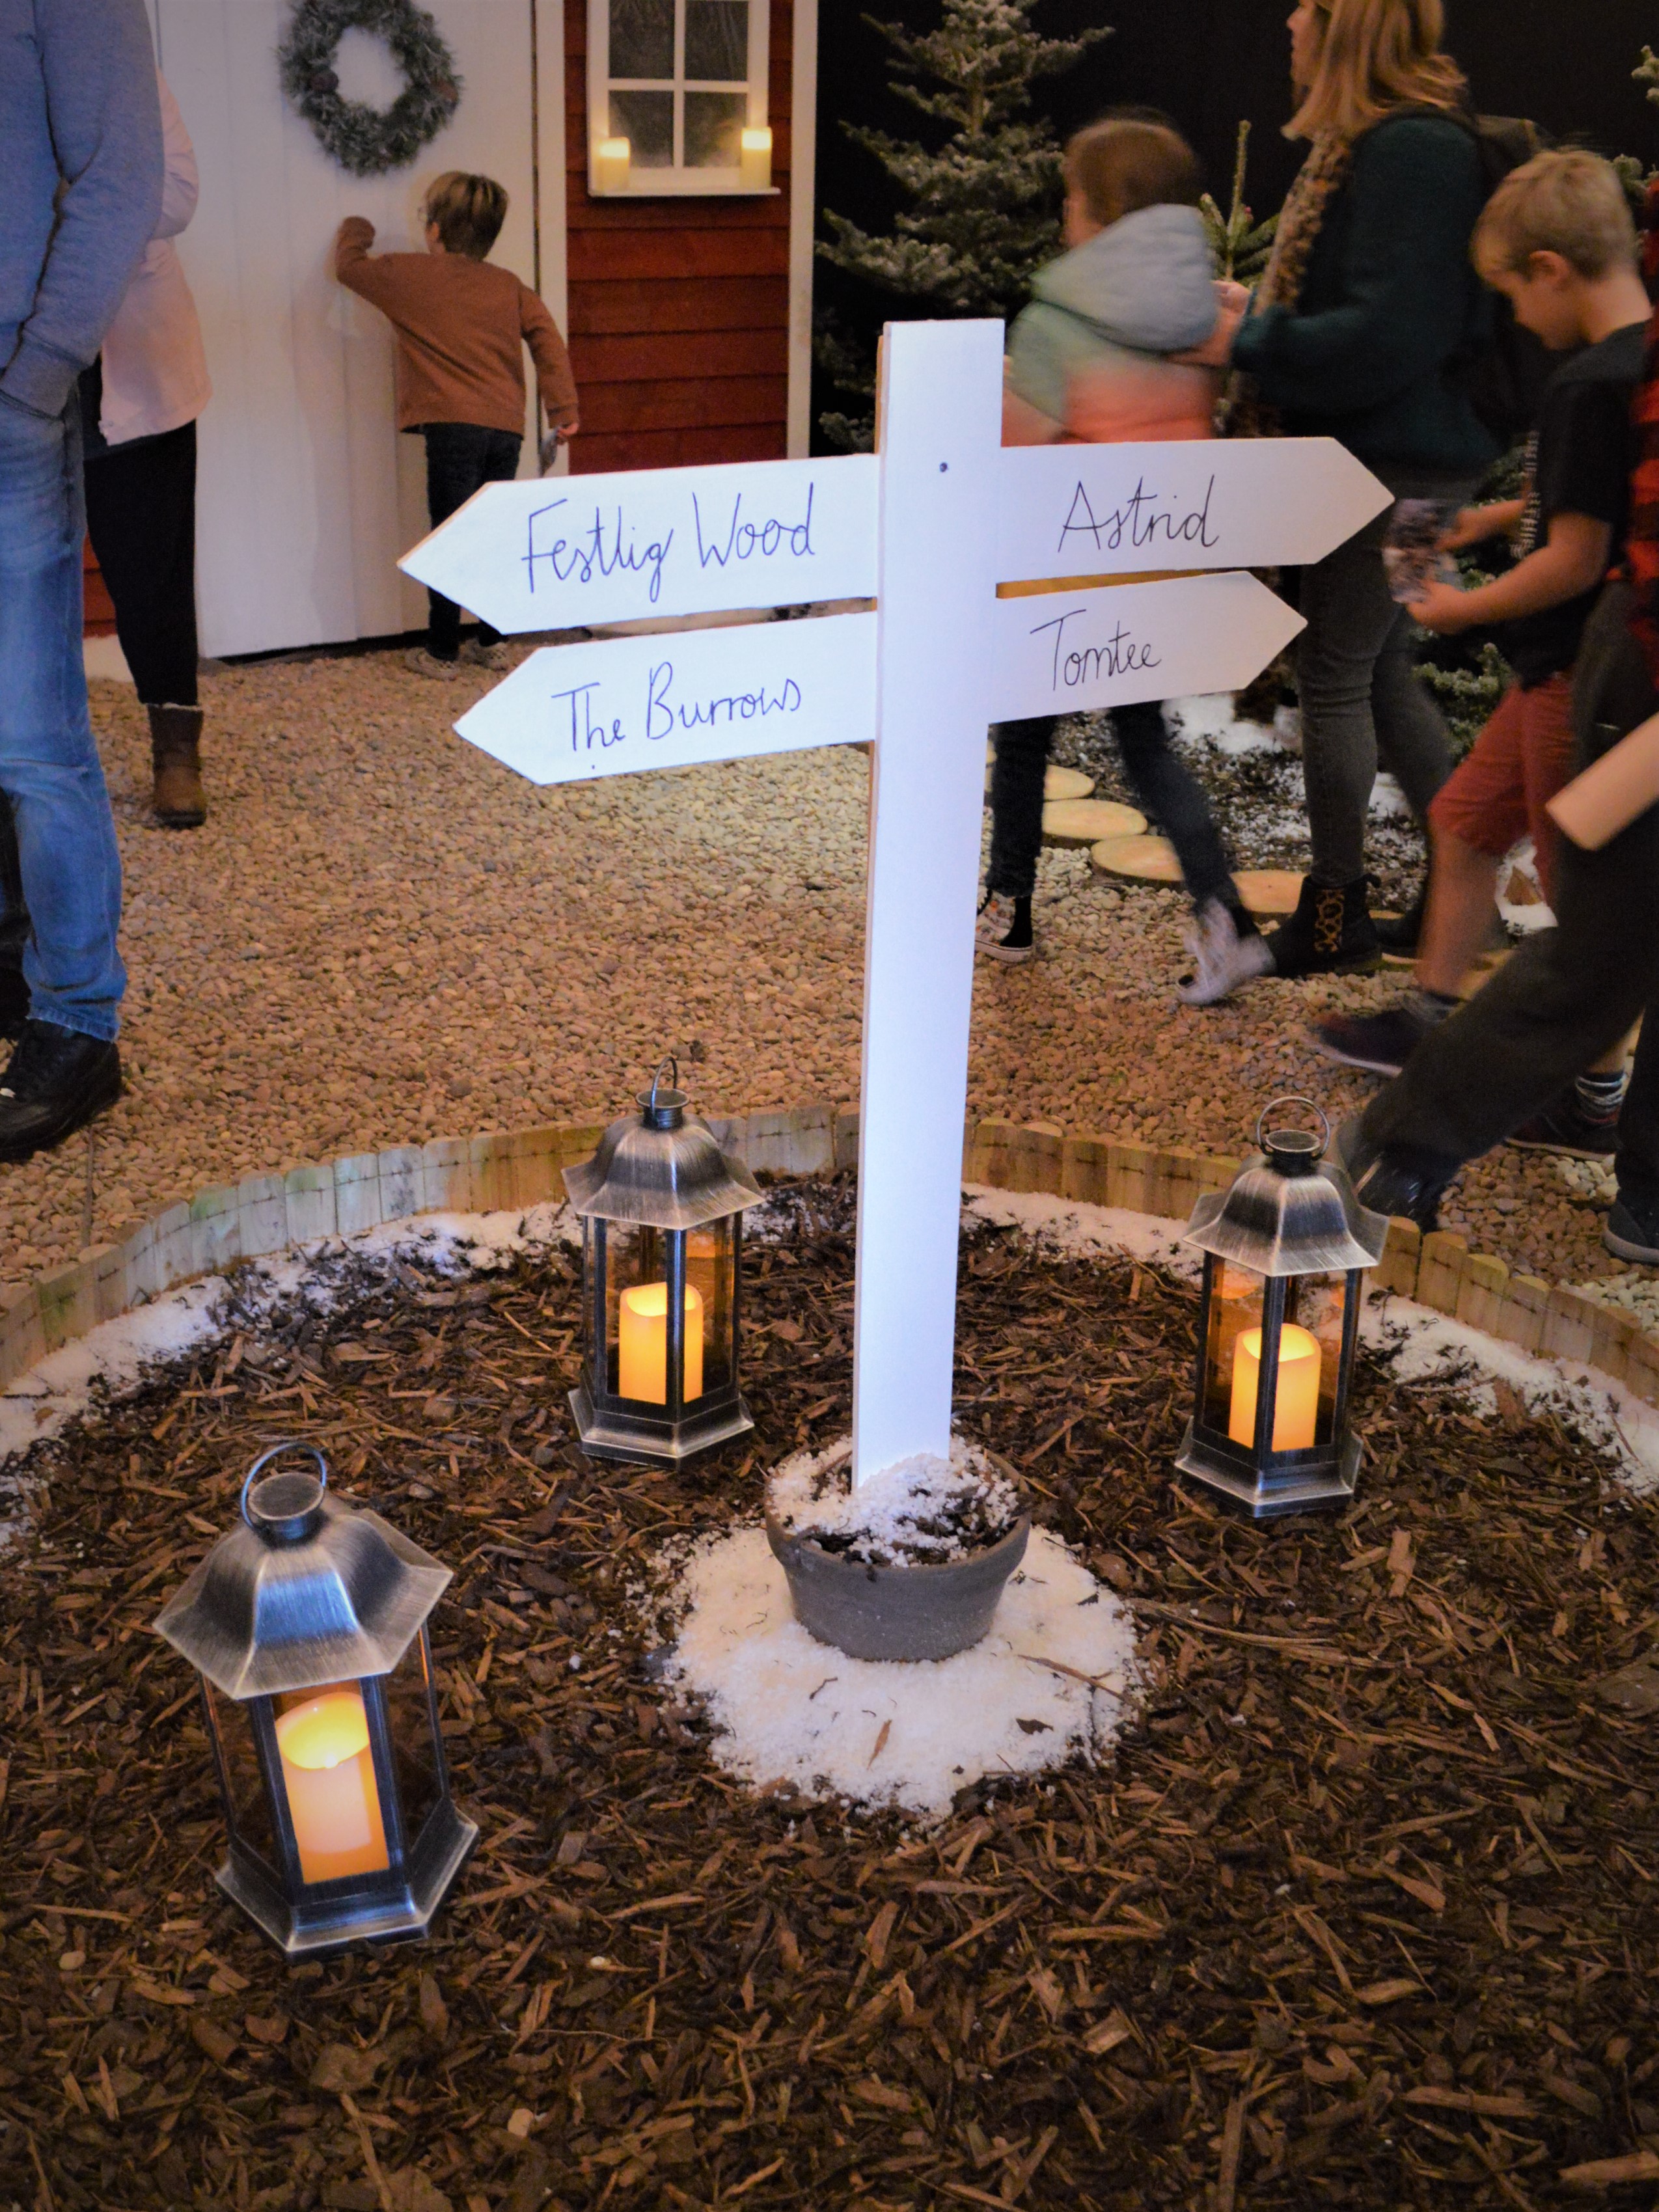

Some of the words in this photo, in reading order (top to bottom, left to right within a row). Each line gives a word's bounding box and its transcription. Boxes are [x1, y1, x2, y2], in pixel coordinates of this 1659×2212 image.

[521, 498, 674, 602] Festlig
[692, 482, 816, 568] Wood
[1058, 474, 1219, 553] Astrid
[1030, 608, 1162, 691] Tomtee
[551, 682, 626, 752] The
[646, 661, 801, 740] Burrows
